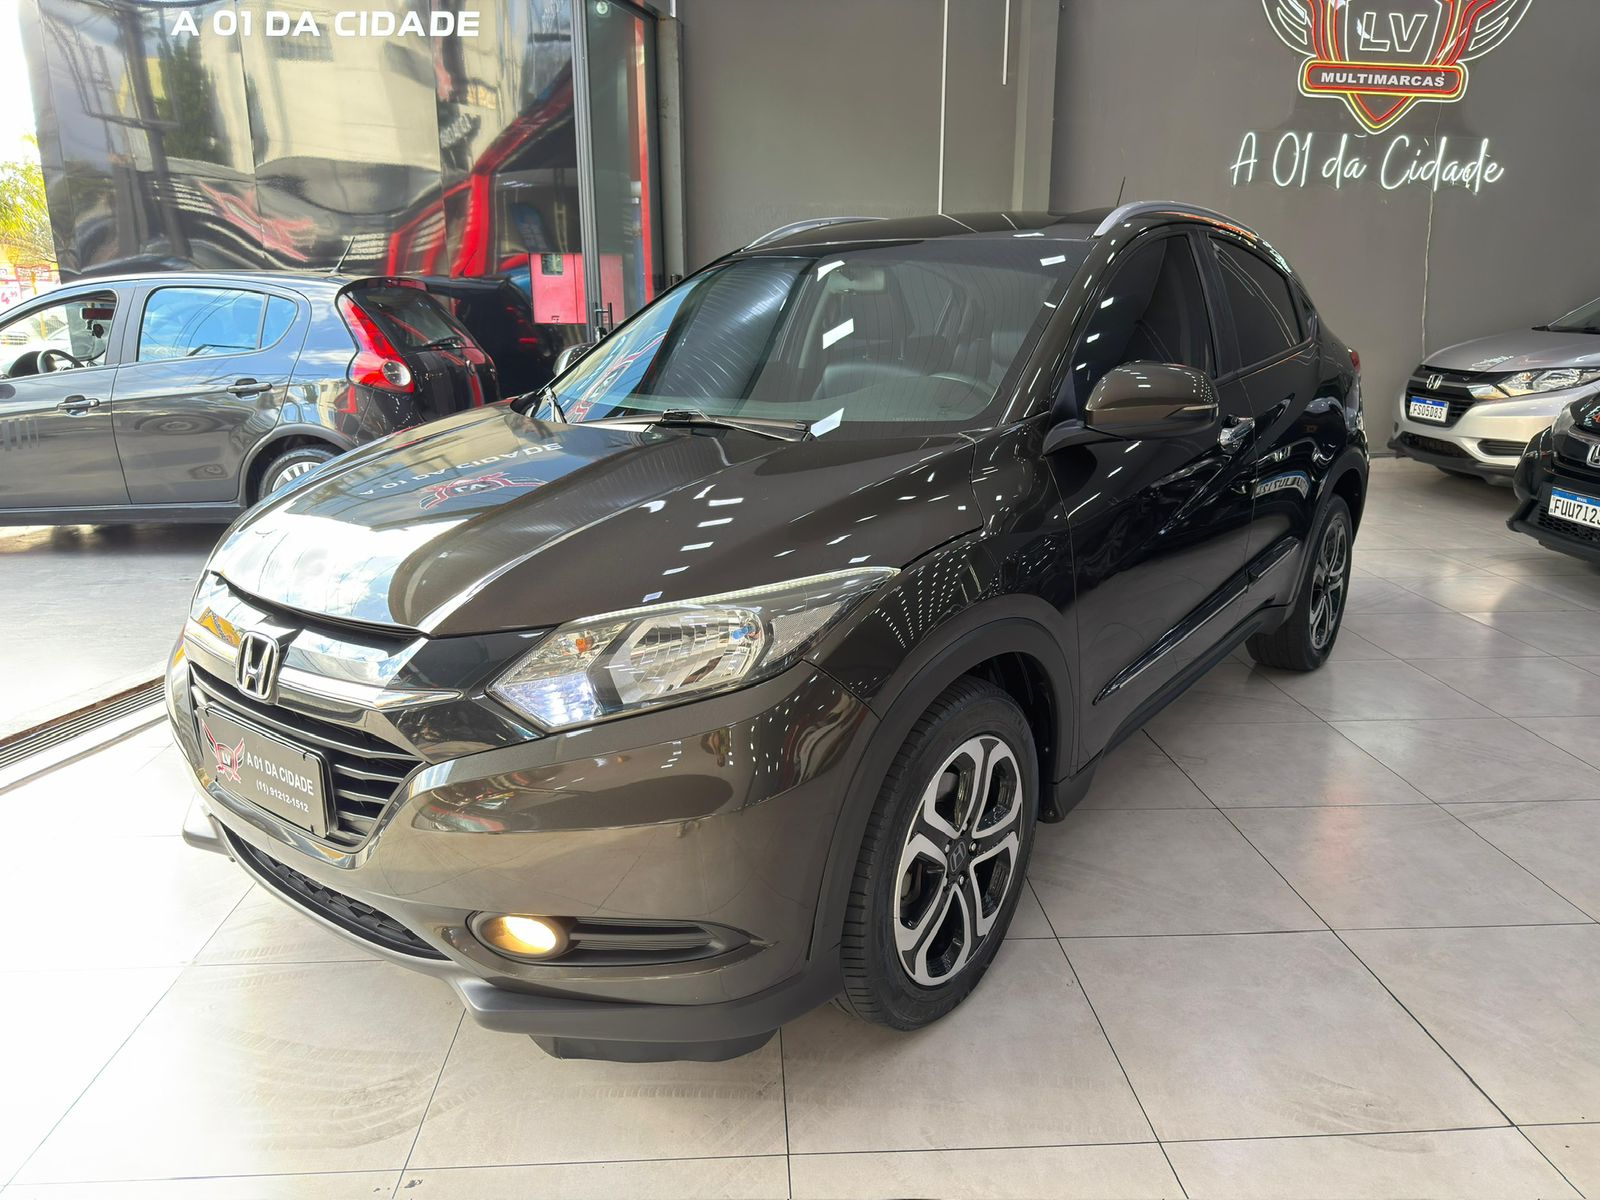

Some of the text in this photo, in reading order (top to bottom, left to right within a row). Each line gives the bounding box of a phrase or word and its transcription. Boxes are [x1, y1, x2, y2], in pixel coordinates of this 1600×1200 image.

[171, 10, 480, 36] A 01 DA CIDADE
[1359, 11, 1428, 52] LV
[1320, 72, 1445, 87] MULTIMARCAS
[1230, 131, 1258, 187] A
[1321, 132, 1367, 190] da
[1380, 134, 1505, 193] Cidade
[246, 751, 315, 796] A 01 DA CIDADE
[256, 779, 310, 813] (11) 91212-1512
